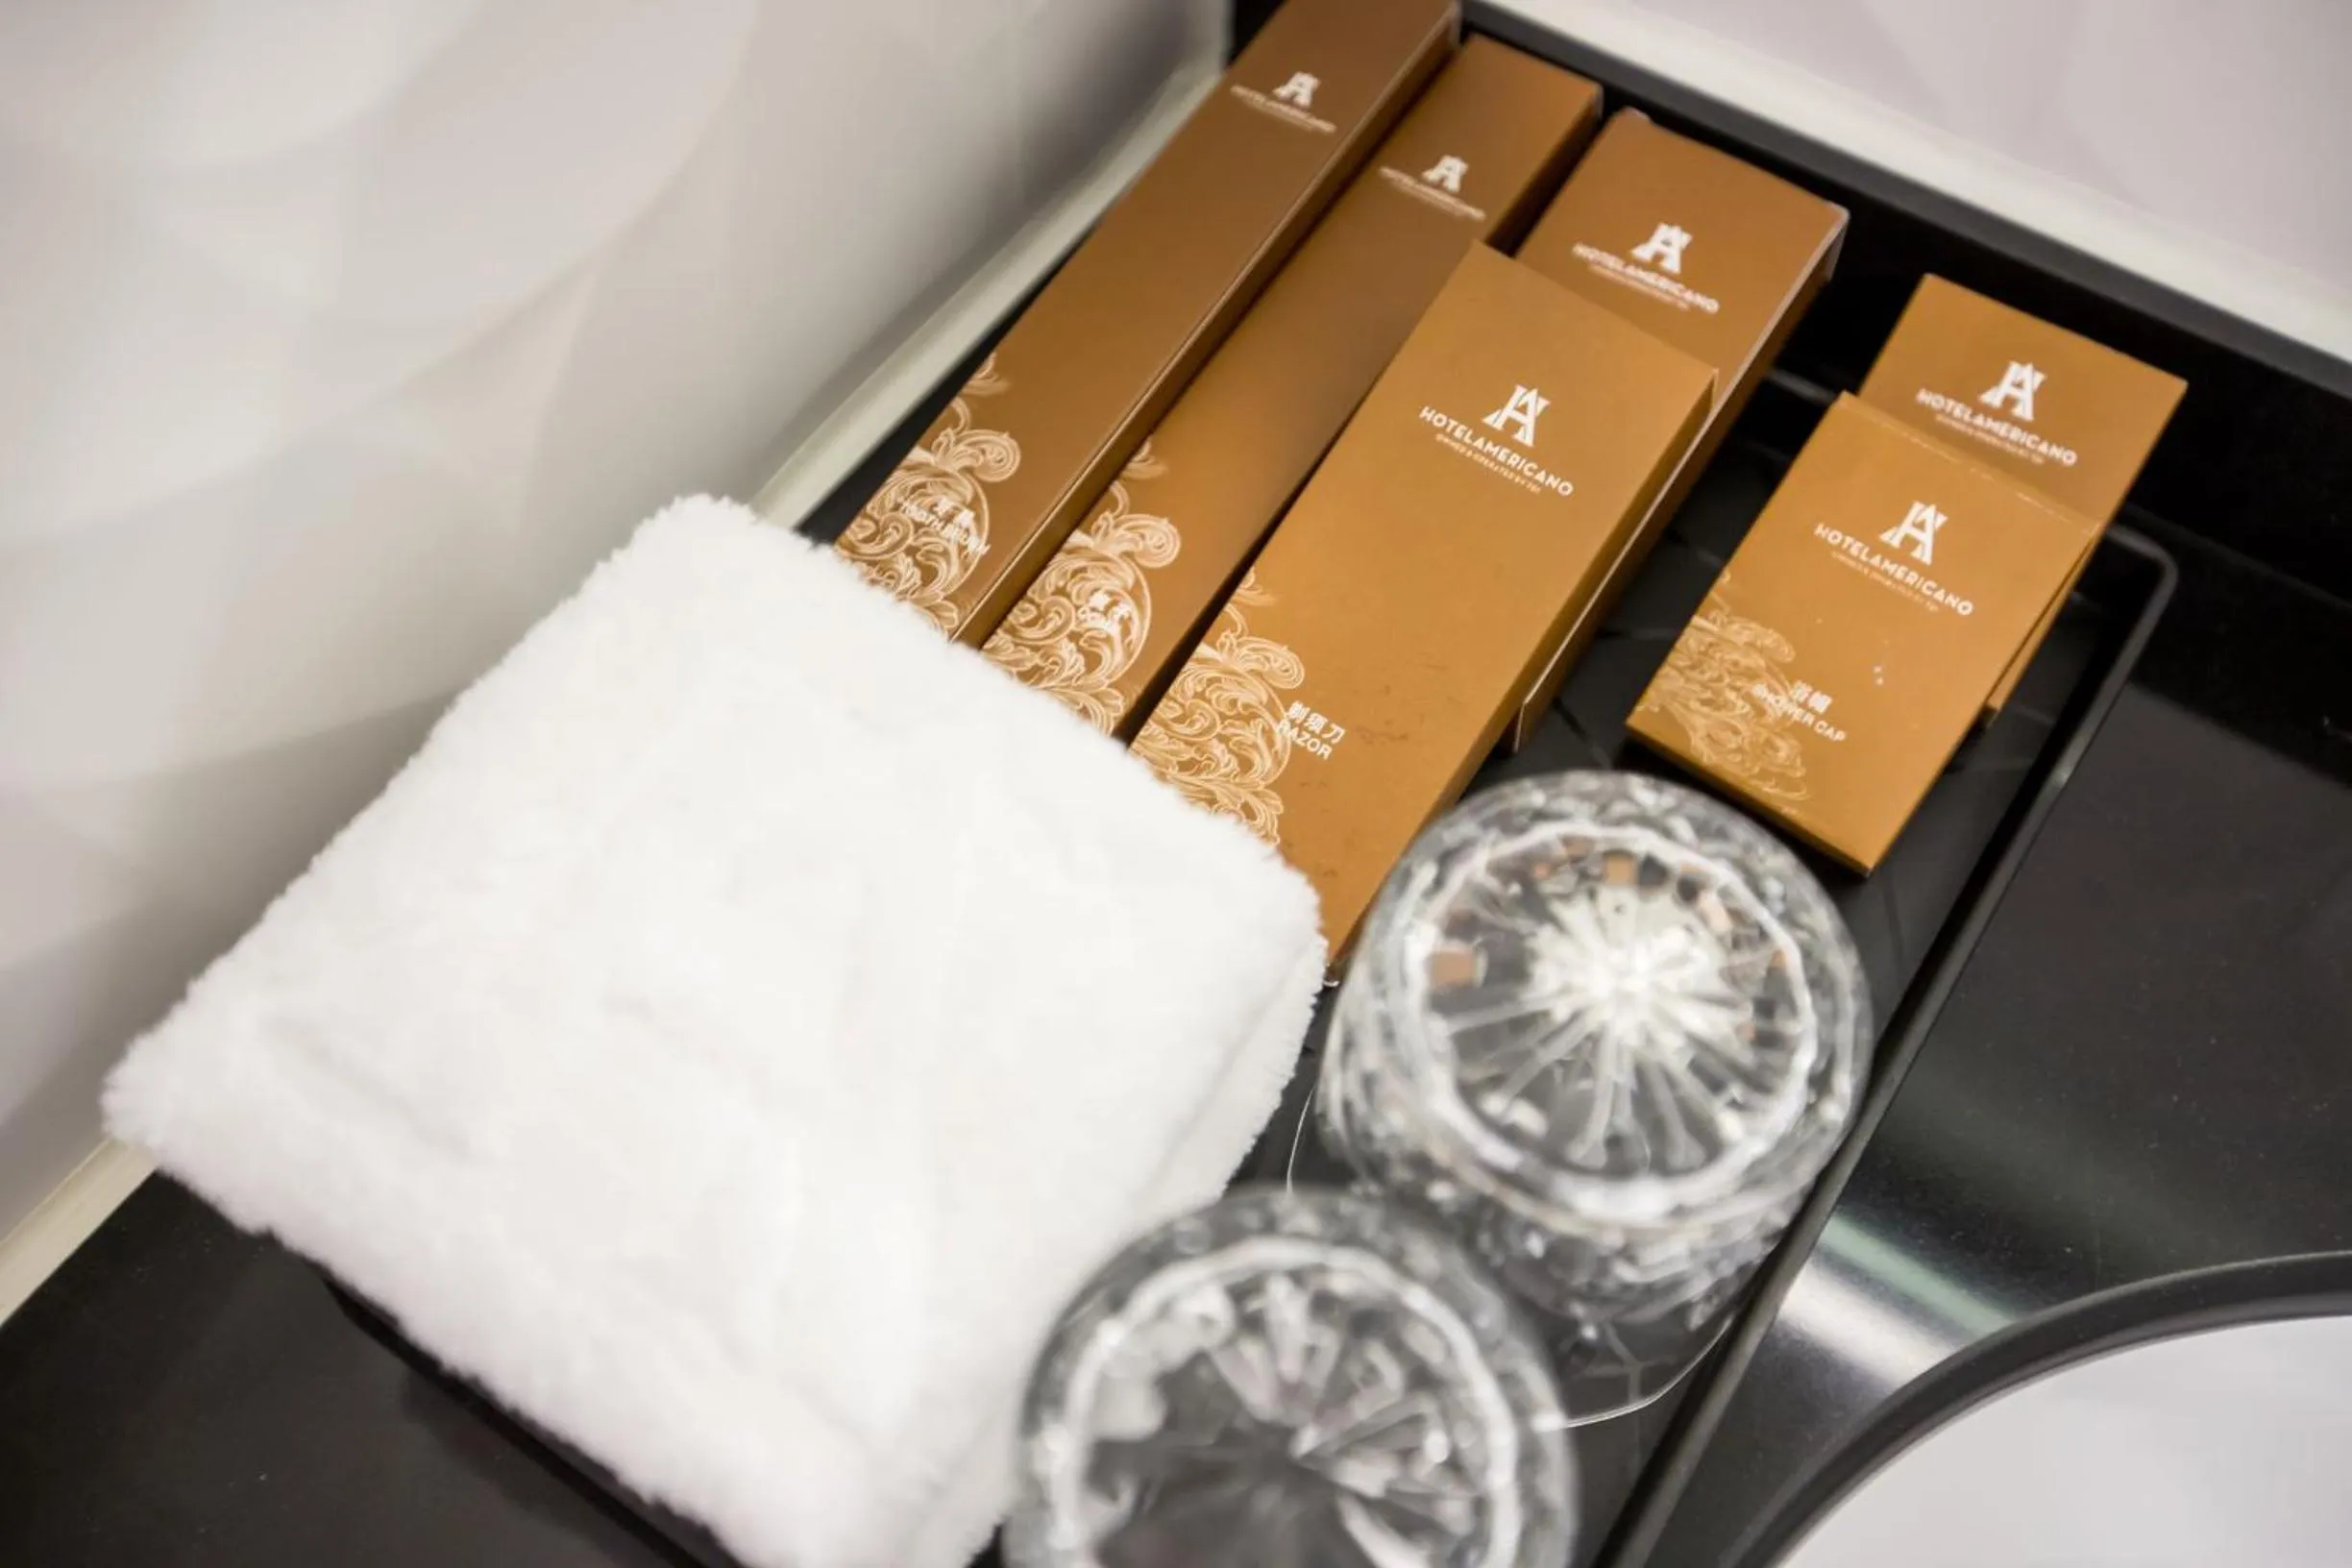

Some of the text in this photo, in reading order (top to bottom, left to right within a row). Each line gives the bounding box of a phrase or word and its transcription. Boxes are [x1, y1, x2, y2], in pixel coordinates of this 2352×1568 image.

[1418, 404, 1574, 497] HOTELAMERICANO
[1916, 387, 2078, 467] HOTELAMERICANO
[1814, 523, 1974, 616] HOTELAMERICANO
[1277, 719, 1333, 761] RAZOR
[1813, 721, 1847, 742] CAP
